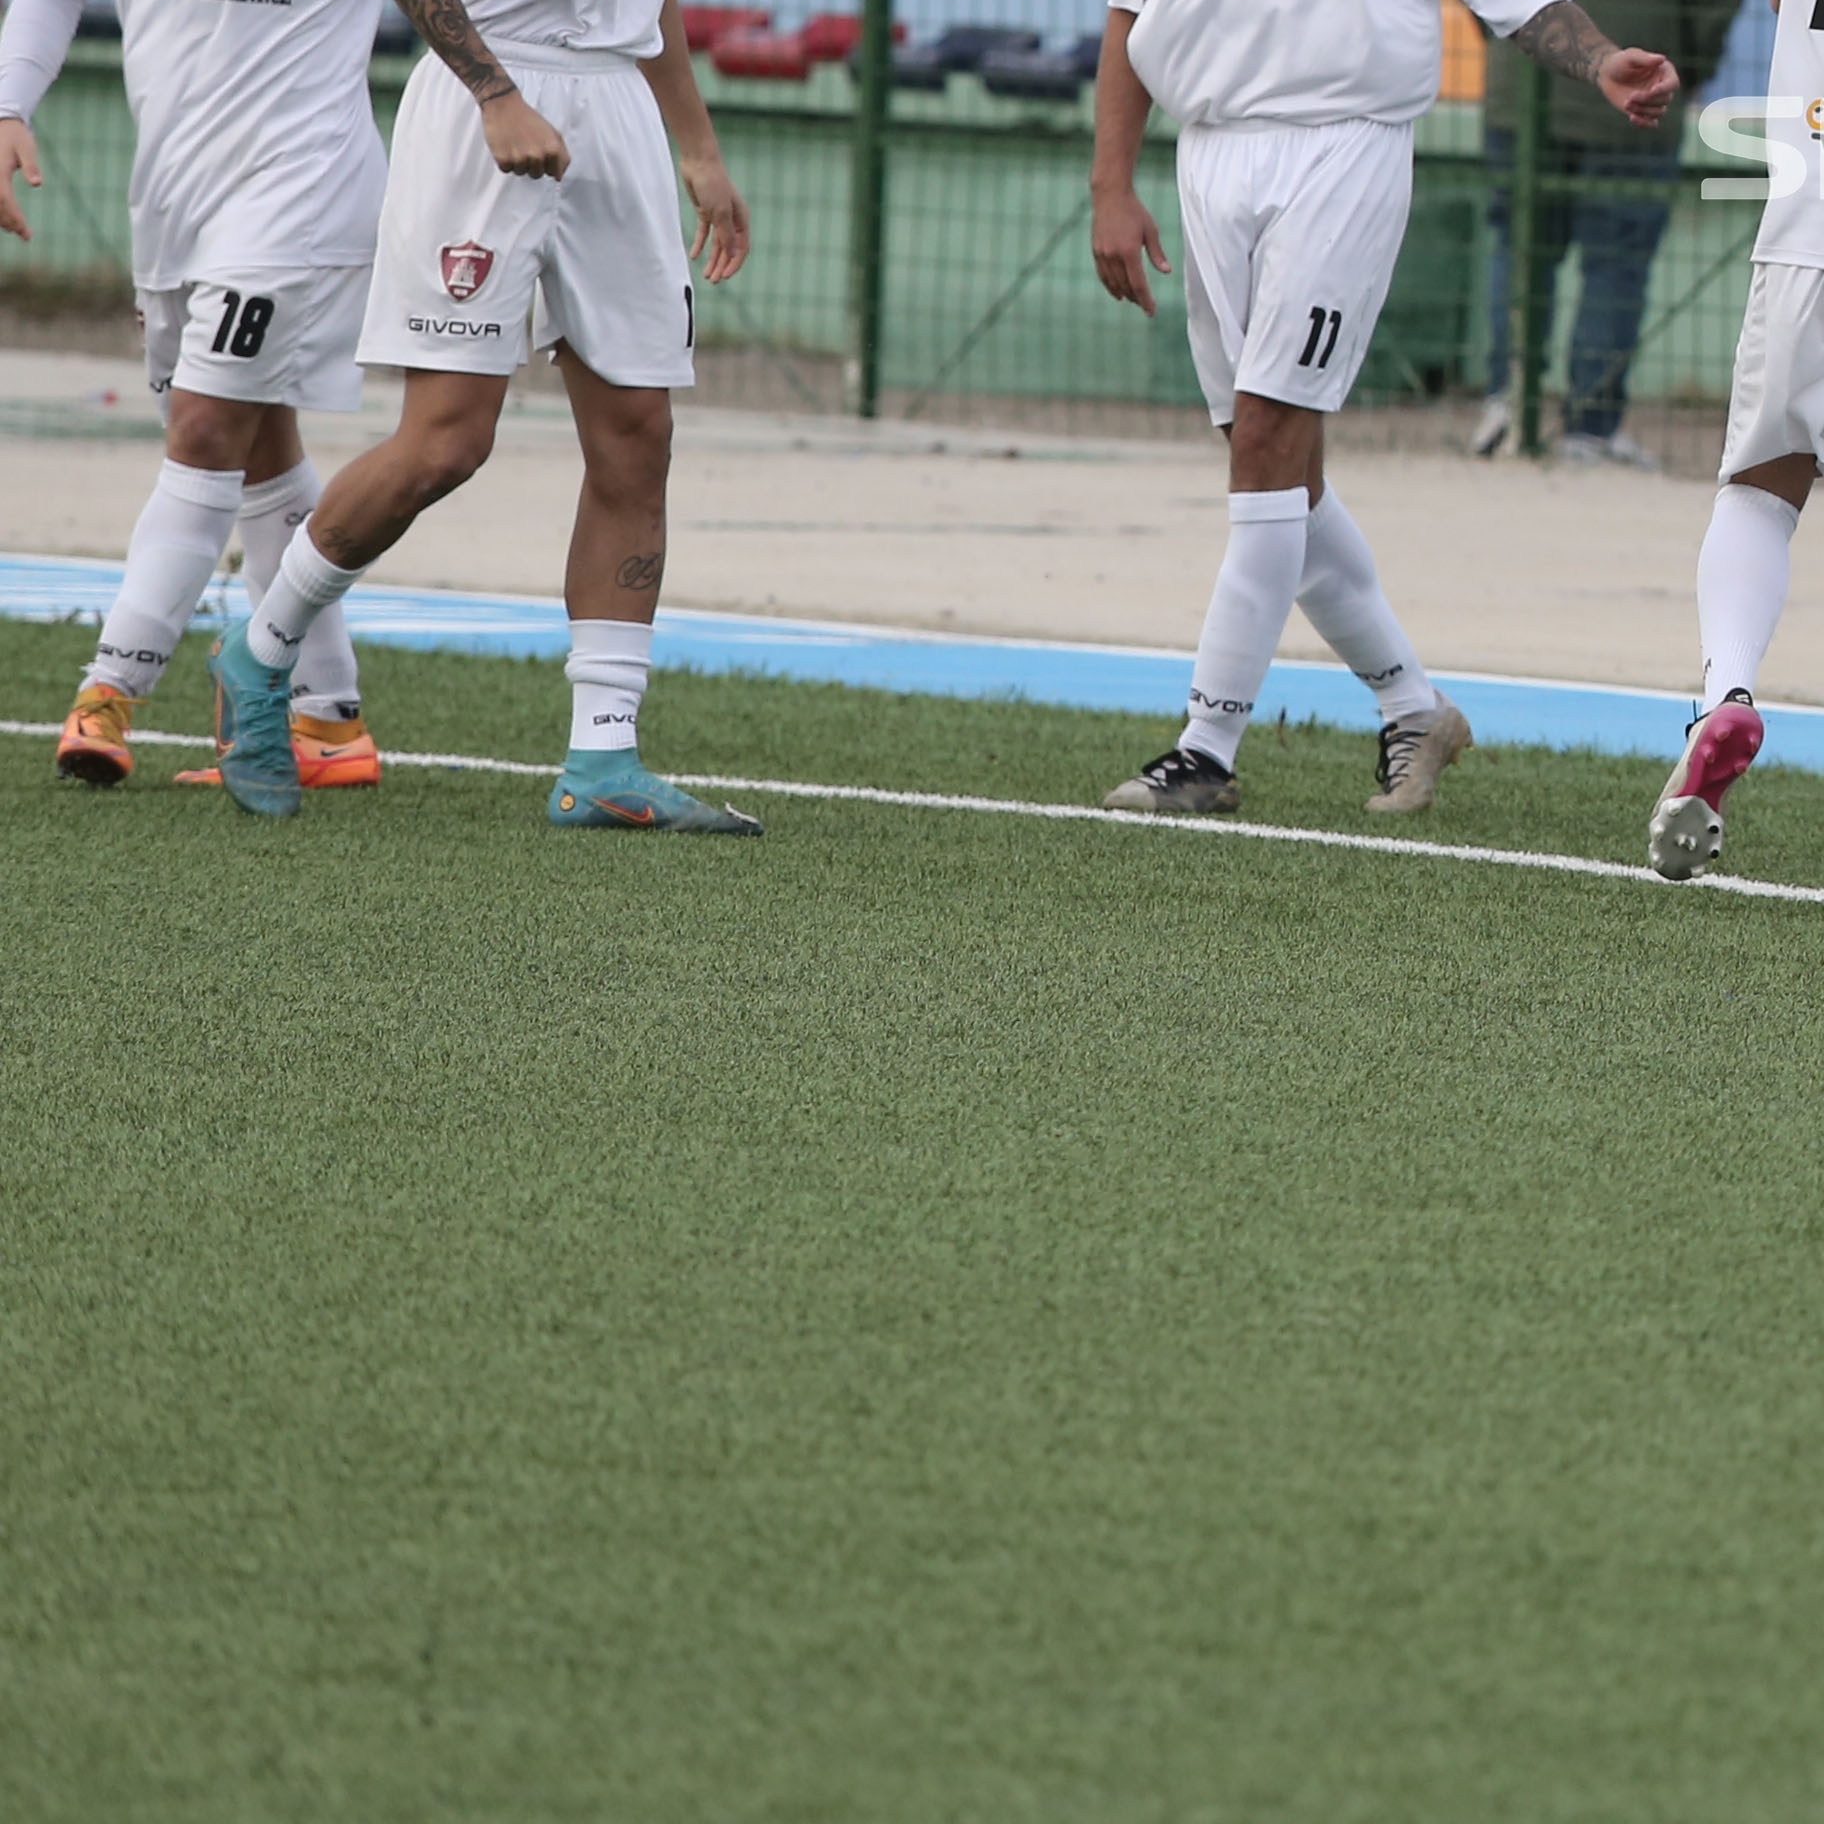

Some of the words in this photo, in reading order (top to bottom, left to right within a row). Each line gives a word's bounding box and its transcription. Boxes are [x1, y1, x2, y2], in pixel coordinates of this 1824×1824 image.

[211, 291, 274, 358] 18
[408, 318, 501, 336] GIVOVA
[1298, 305, 1342, 369] 11
